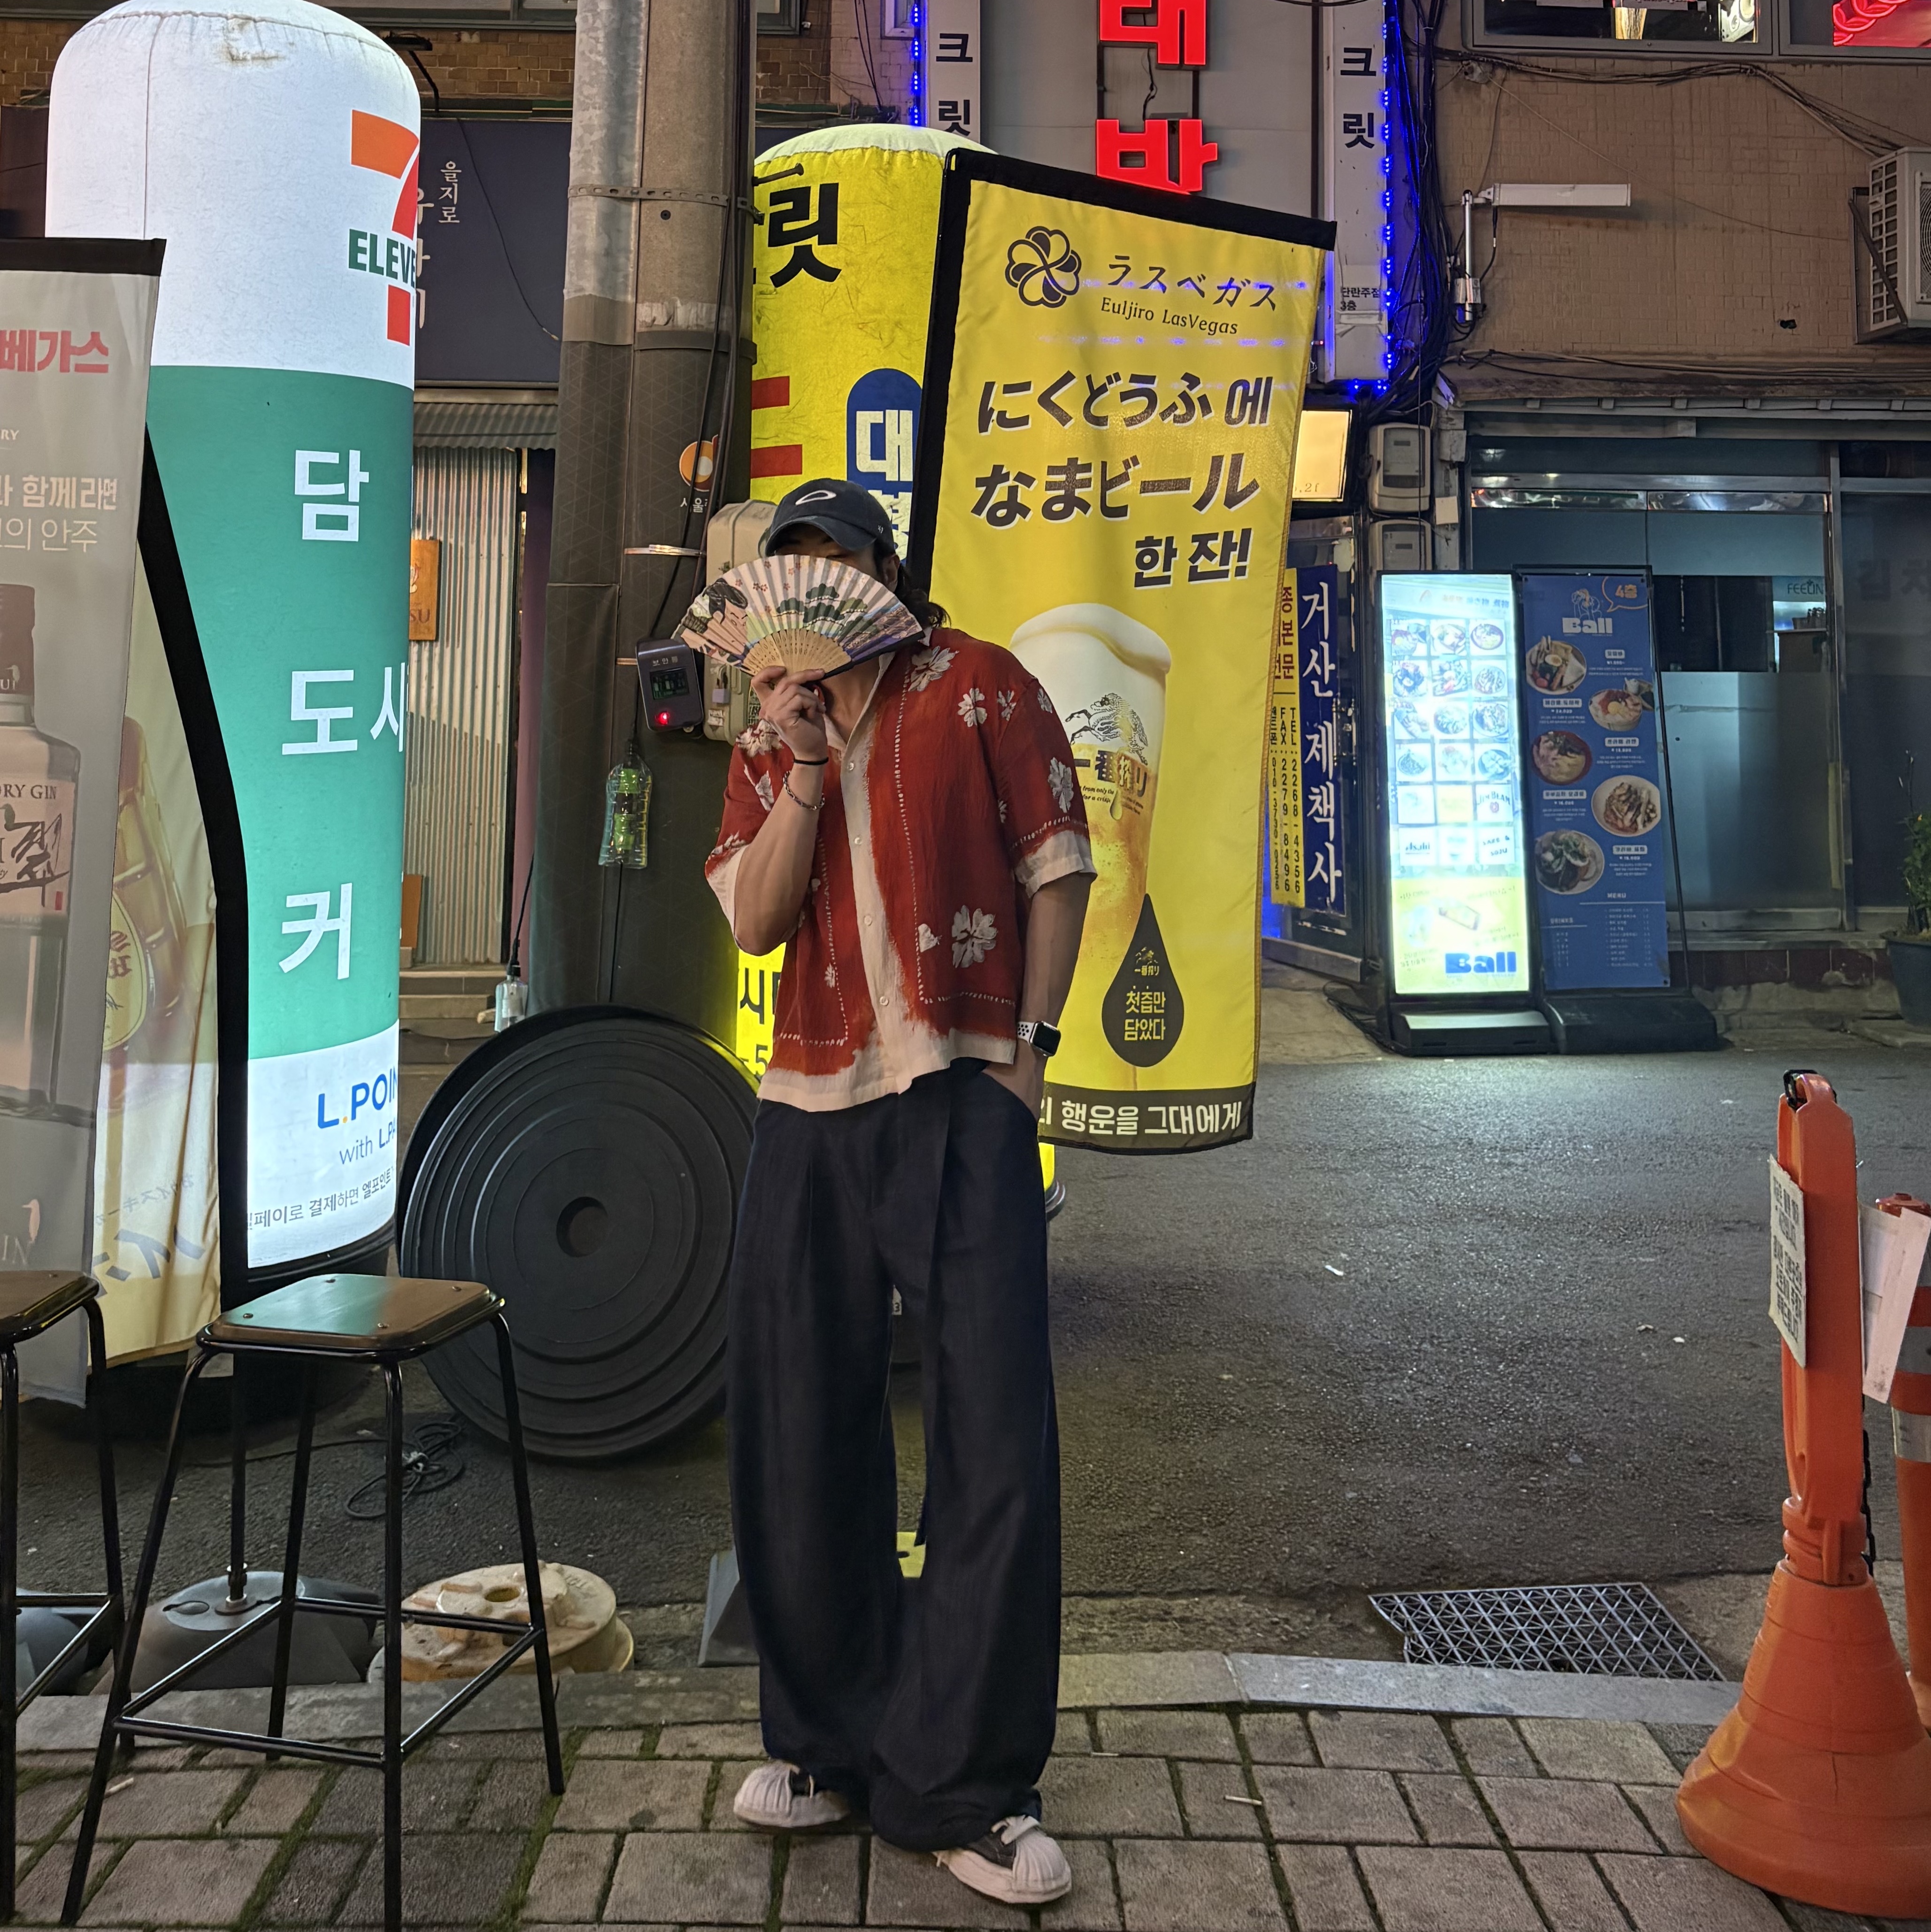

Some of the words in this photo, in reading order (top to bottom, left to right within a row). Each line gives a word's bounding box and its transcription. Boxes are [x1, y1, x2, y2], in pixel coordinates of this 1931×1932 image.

[1340, 47, 1377, 148] 크릿
[439, 161, 462, 224] 을지로
[1108, 255, 1276, 311] ラスベガス
[1101, 297, 1154, 320] Euljiro
[1162, 309, 1239, 336] LasVegas
[971, 453, 1261, 529] なまビール
[0, 518, 31, 551] 의
[41, 519, 97, 553] 안주
[1134, 535, 1177, 588] 한
[1188, 528, 1253, 583] 잔!
[1562, 617, 1613, 633] Ball
[0, 784, 25, 799] RY
[31, 785, 57, 800] GIN
[279, 883, 353, 979] 커
[1445, 951, 1516, 974] Ball
[1124, 1018, 1166, 1041] 담았다
[1062, 1100, 1139, 1135] 행운을
[1145, 1101, 1242, 1135] 그대에게
[339, 1135, 373, 1165] with
[249, 1204, 304, 1231] 페이로
[309, 1186, 359, 1217] 결제하면
[362, 1166, 394, 1200] 엘포인트
